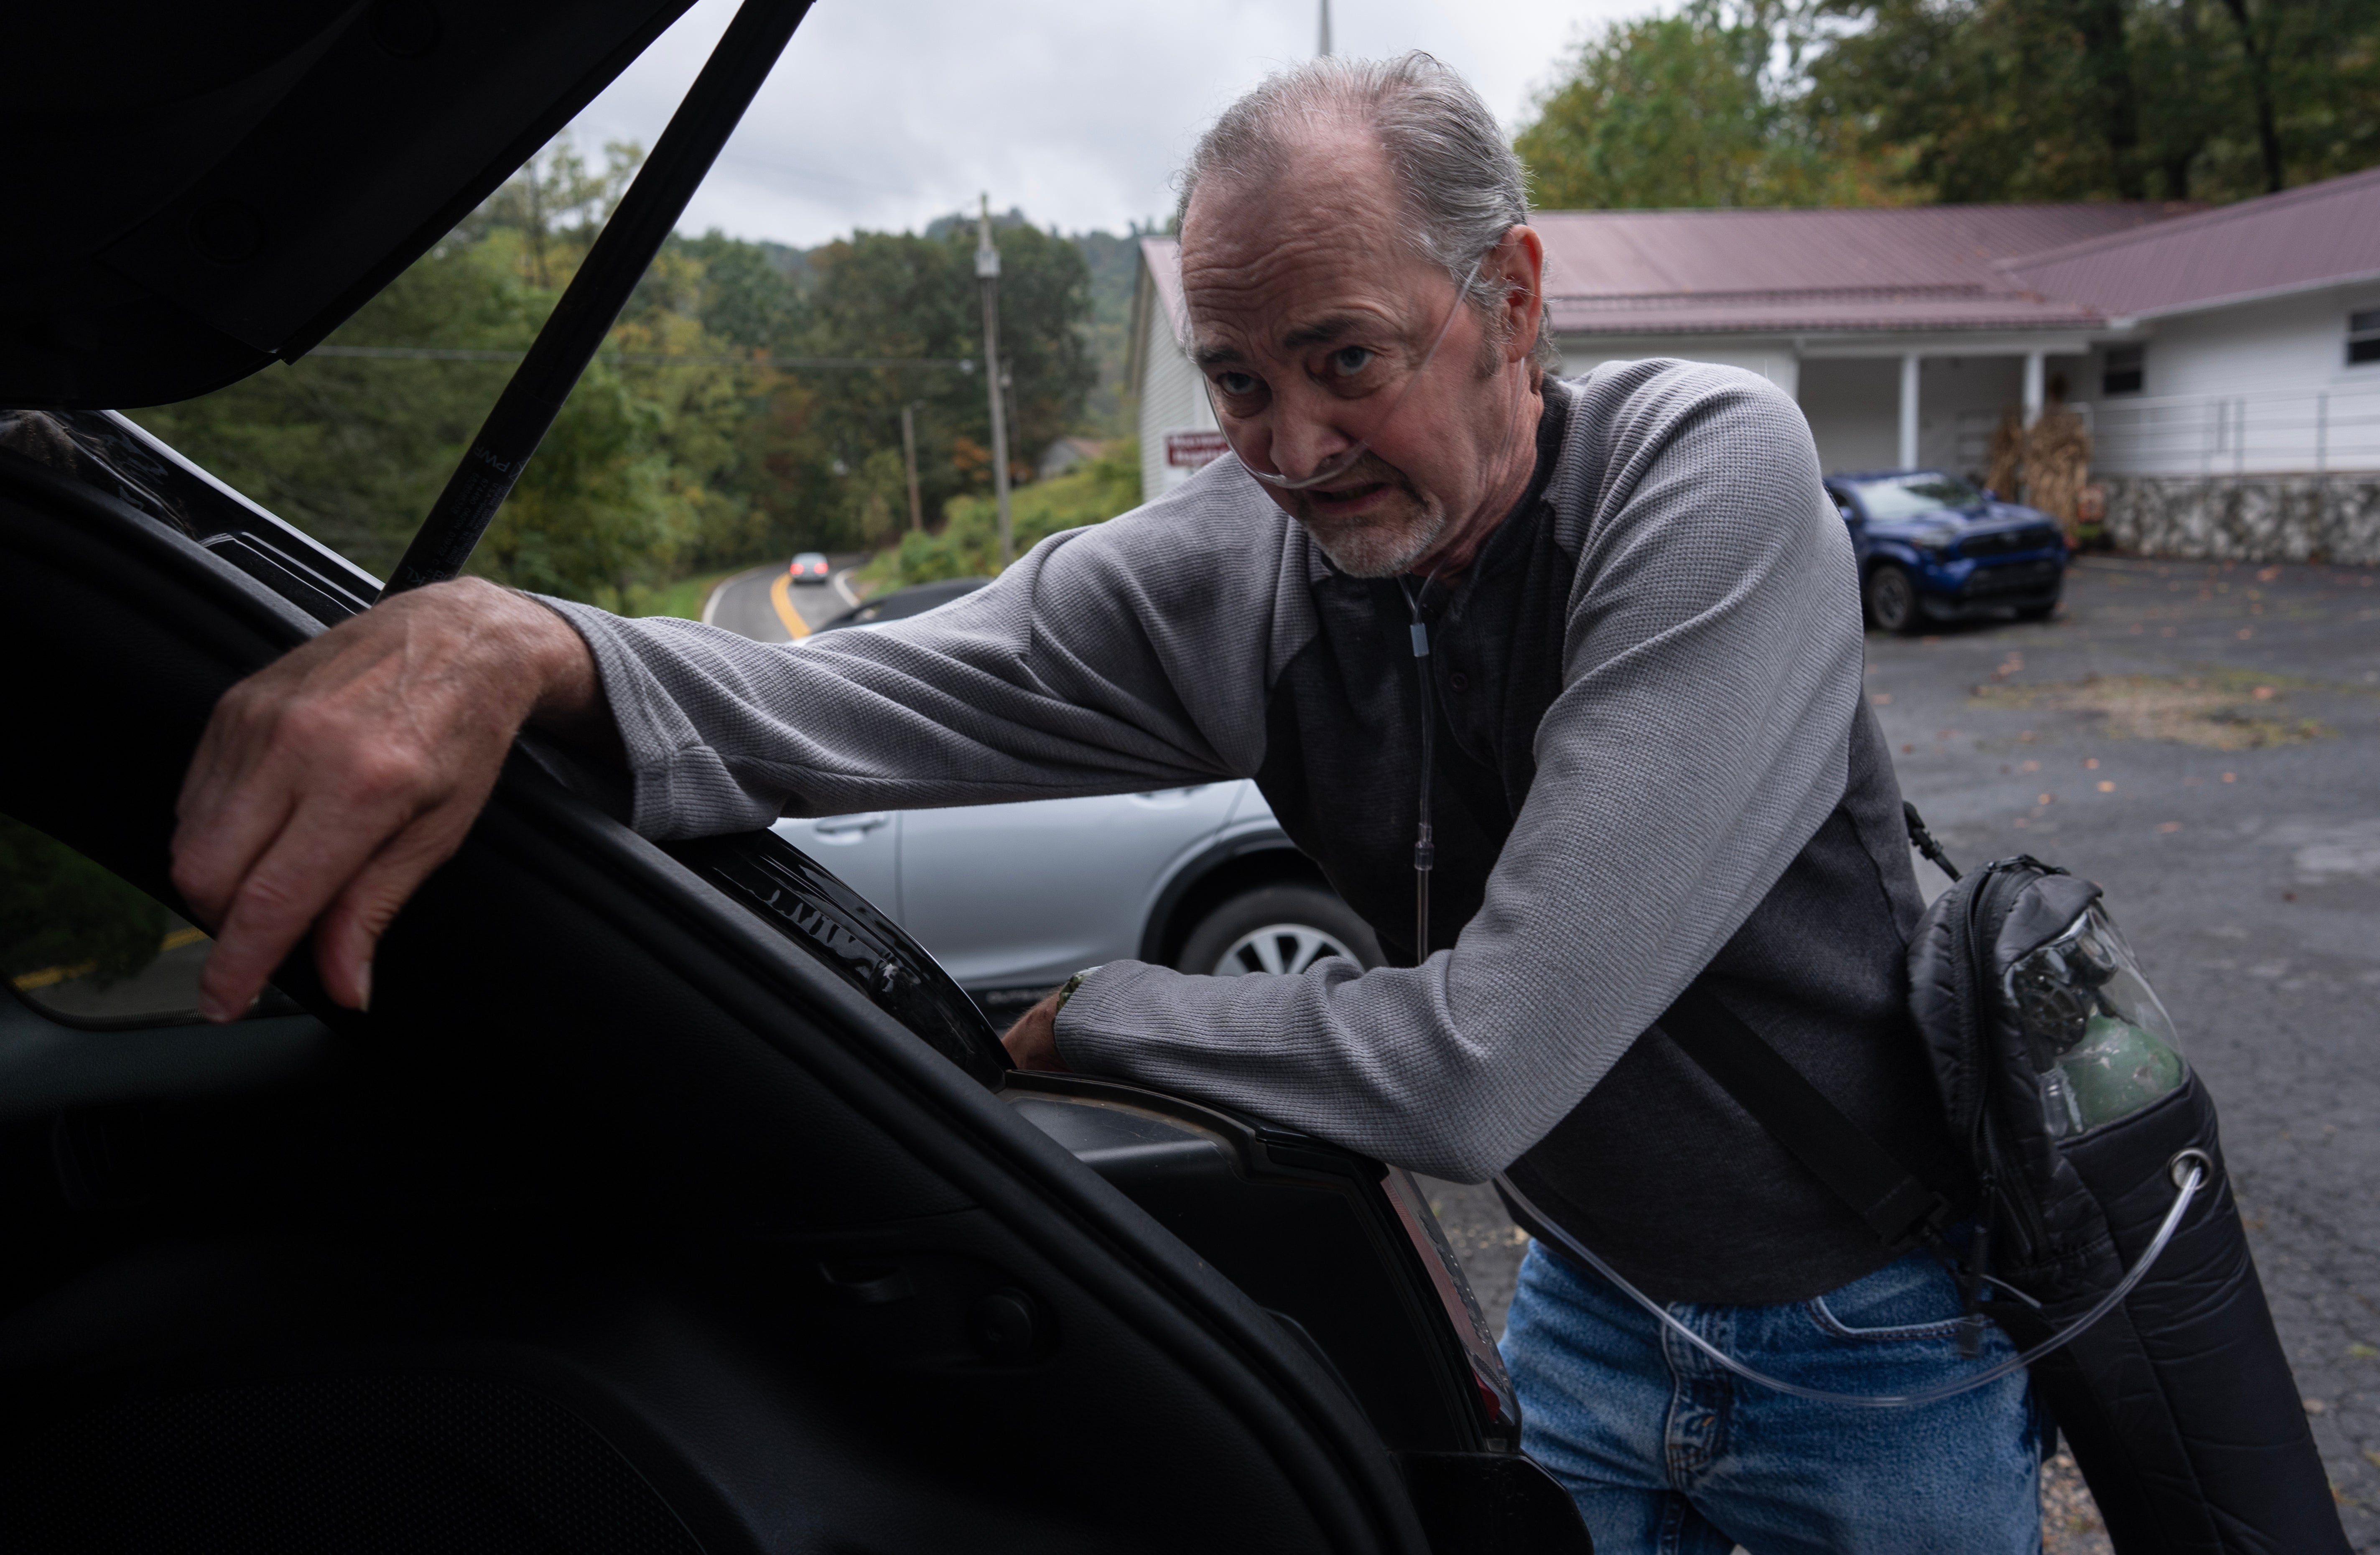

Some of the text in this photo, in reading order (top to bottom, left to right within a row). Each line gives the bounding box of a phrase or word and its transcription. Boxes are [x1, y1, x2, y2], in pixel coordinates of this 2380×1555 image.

[474, 446, 510, 472] PWR
[468, 477, 489, 506] 674490
[437, 531, 456, 556] 039/22
[445, 545, 460, 564] 28052
[431, 557, 440, 566] C
